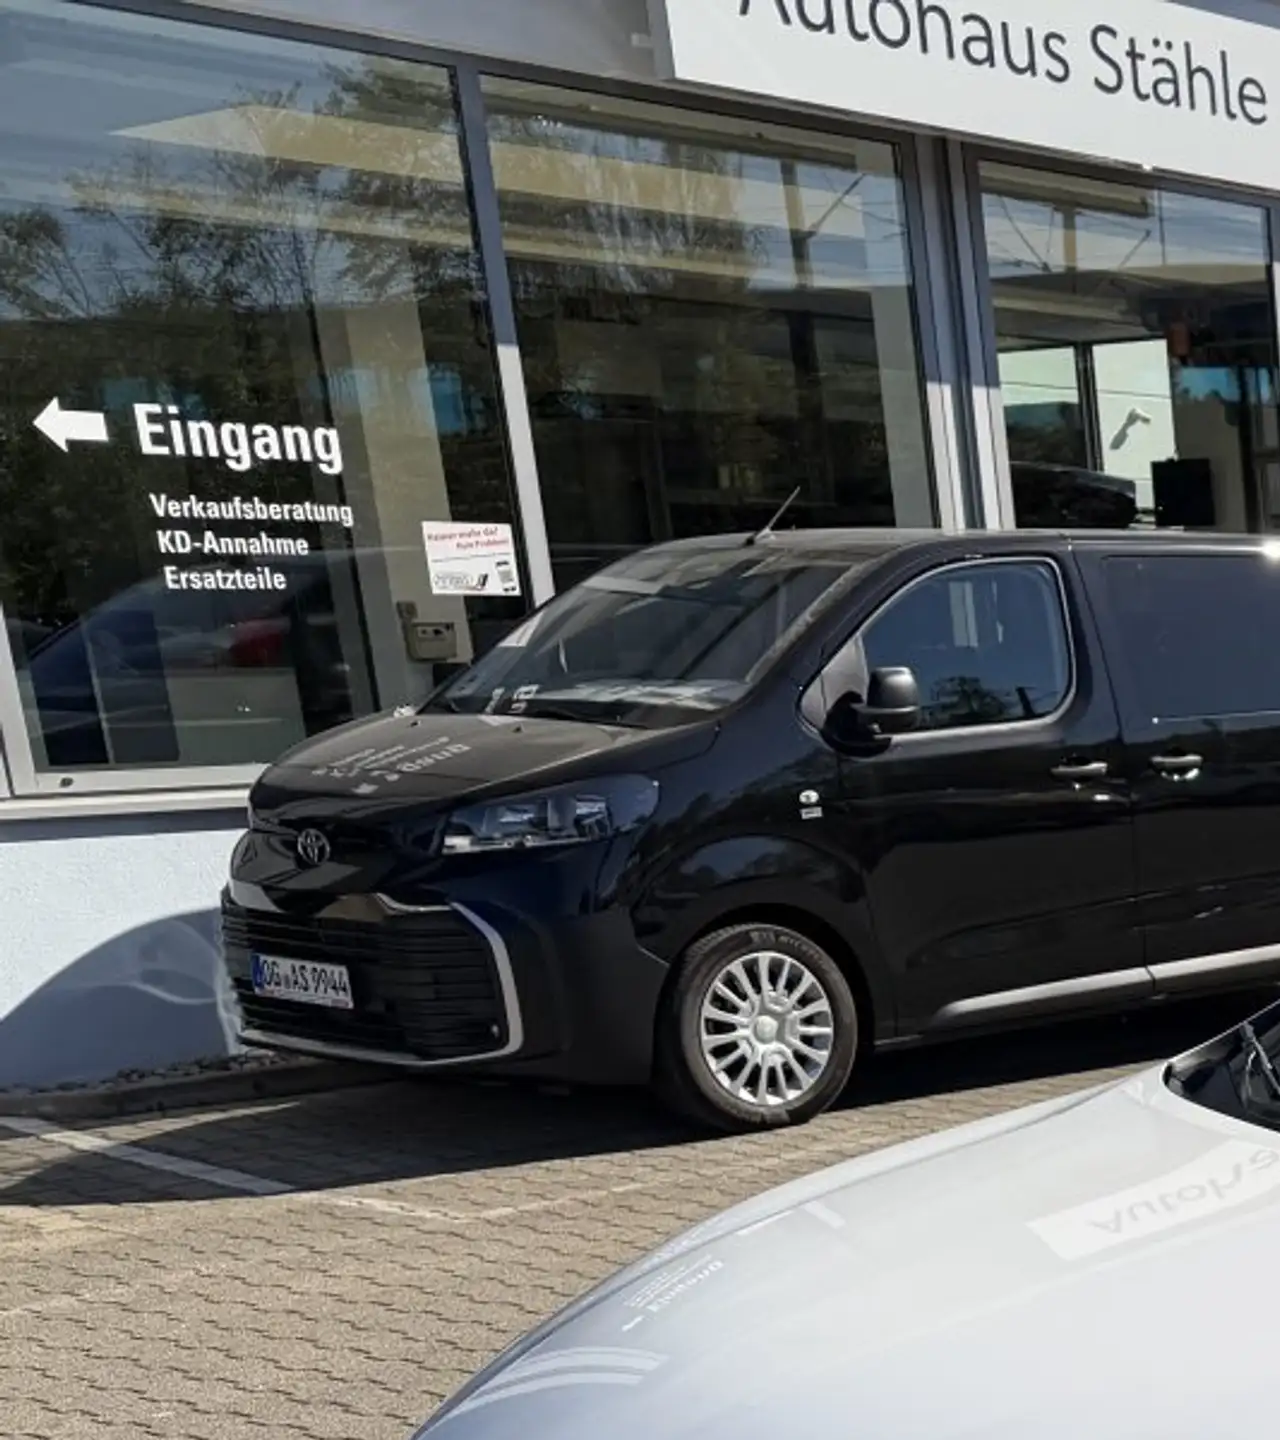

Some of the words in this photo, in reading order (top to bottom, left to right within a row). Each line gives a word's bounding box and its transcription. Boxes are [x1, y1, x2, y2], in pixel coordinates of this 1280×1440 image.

[1090, 23, 1268, 126] Stähle
[133, 402, 343, 475] Eingang
[149, 492, 354, 527] Verkaufsberatung
[156, 529, 309, 556] KD-Annahme
[163, 565, 287, 590] Ersatzteile
